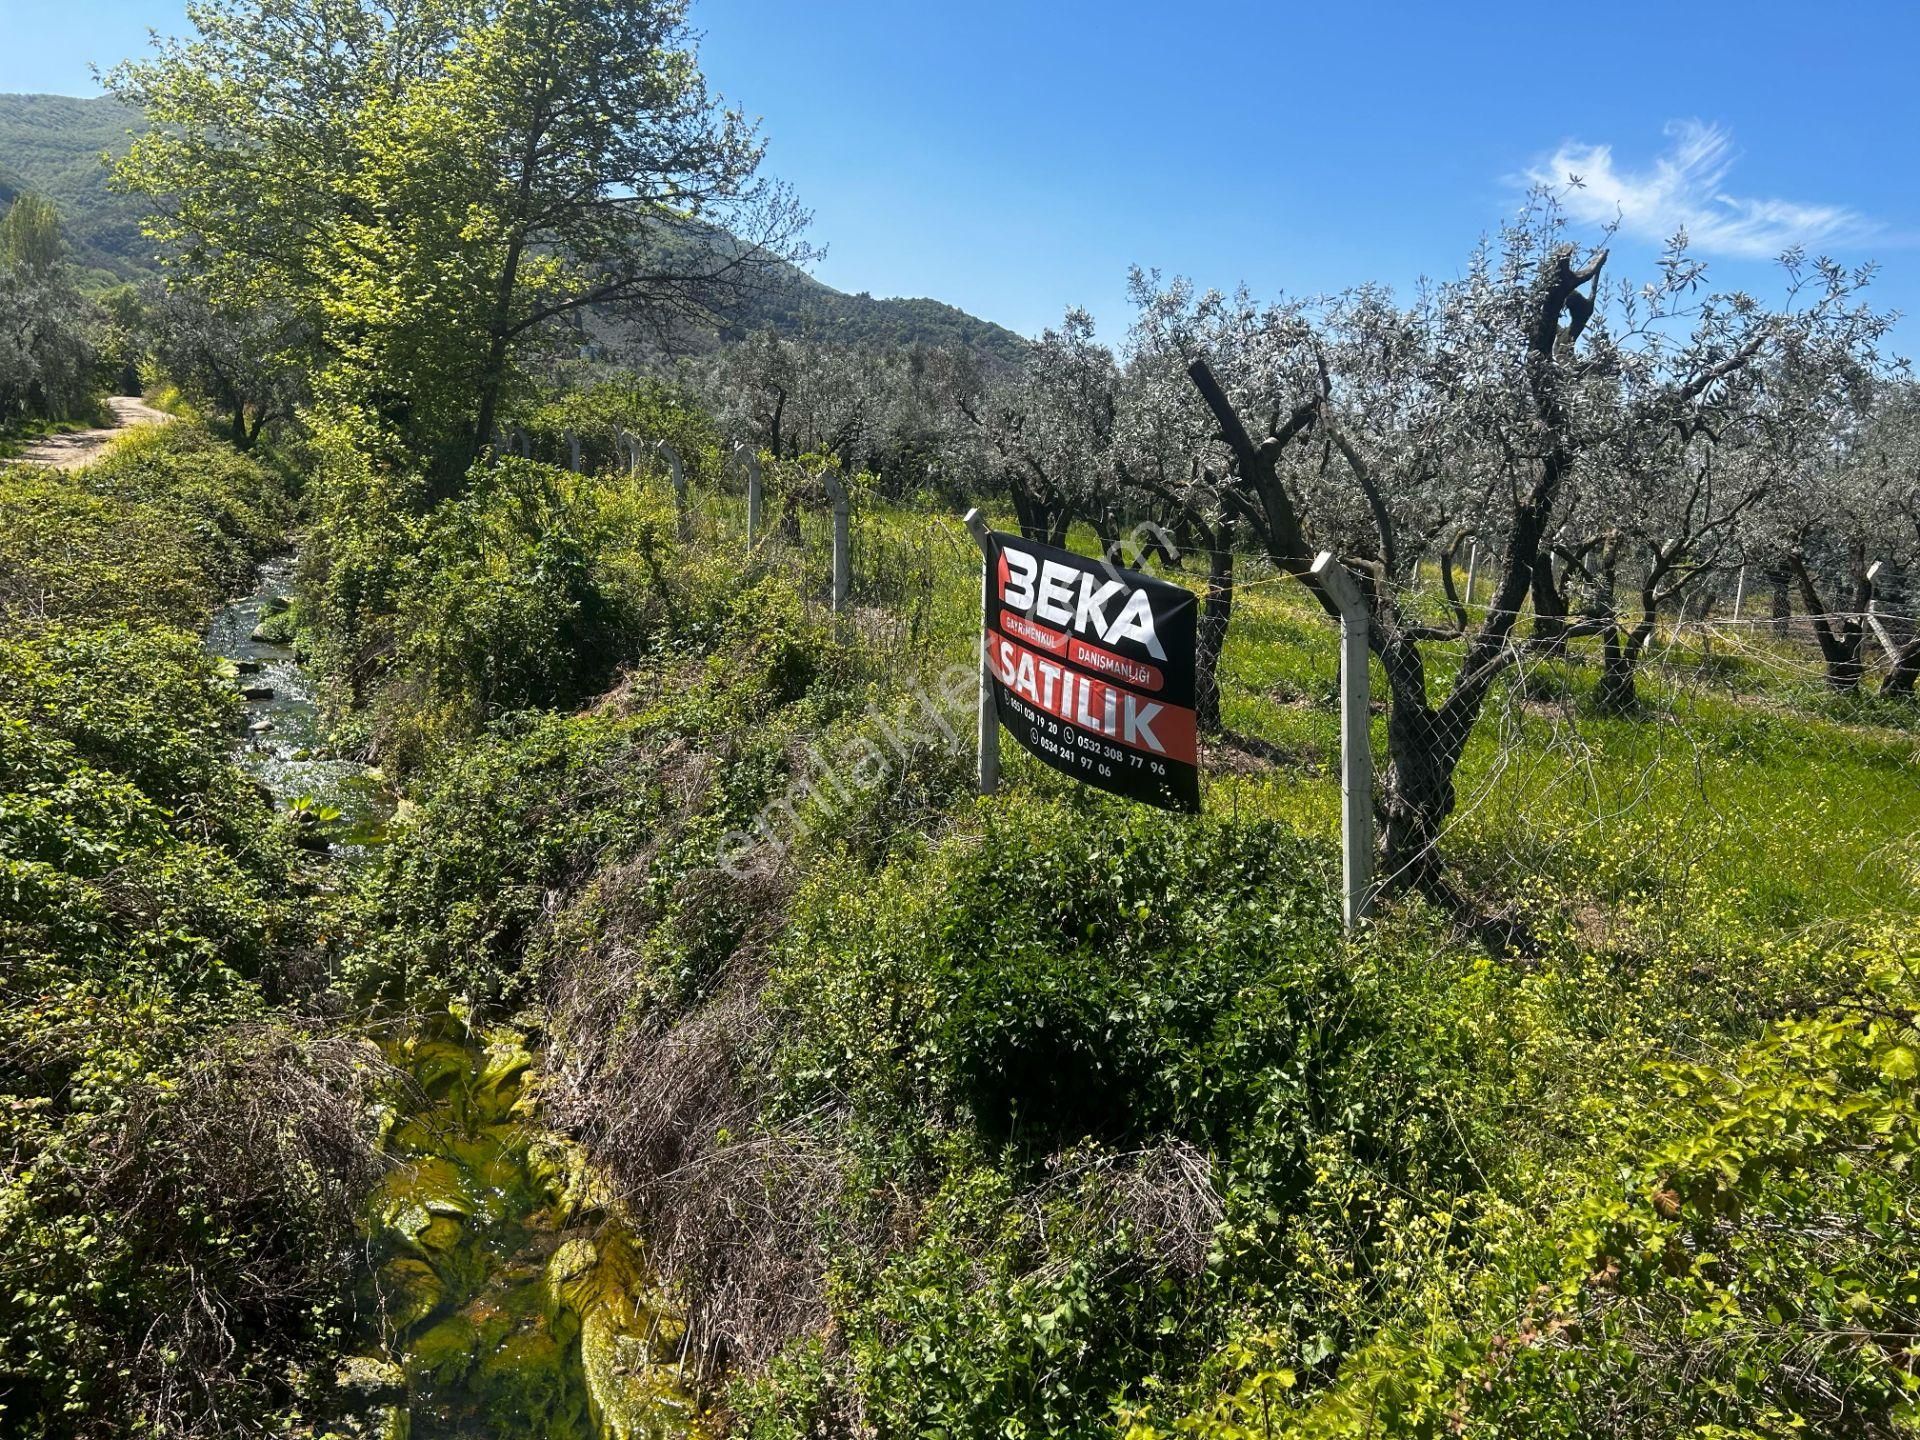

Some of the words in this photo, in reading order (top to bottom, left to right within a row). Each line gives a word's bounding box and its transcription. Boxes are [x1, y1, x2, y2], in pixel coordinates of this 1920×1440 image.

[998, 546, 1168, 661] BEKA
[1000, 641, 1167, 753] SATILIK
[1036, 714, 1045, 728] 19
[1048, 721, 1058, 735] 20
[1077, 735, 1101, 754] 0532
[1103, 746, 1124, 762] 308
[1129, 754, 1144, 769] 77
[1150, 761, 1166, 776] 96
[1040, 736, 1058, 755] 0534
[1060, 747, 1075, 763] 241
[1080, 756, 1093, 770] 97
[1098, 763, 1112, 777] 06
